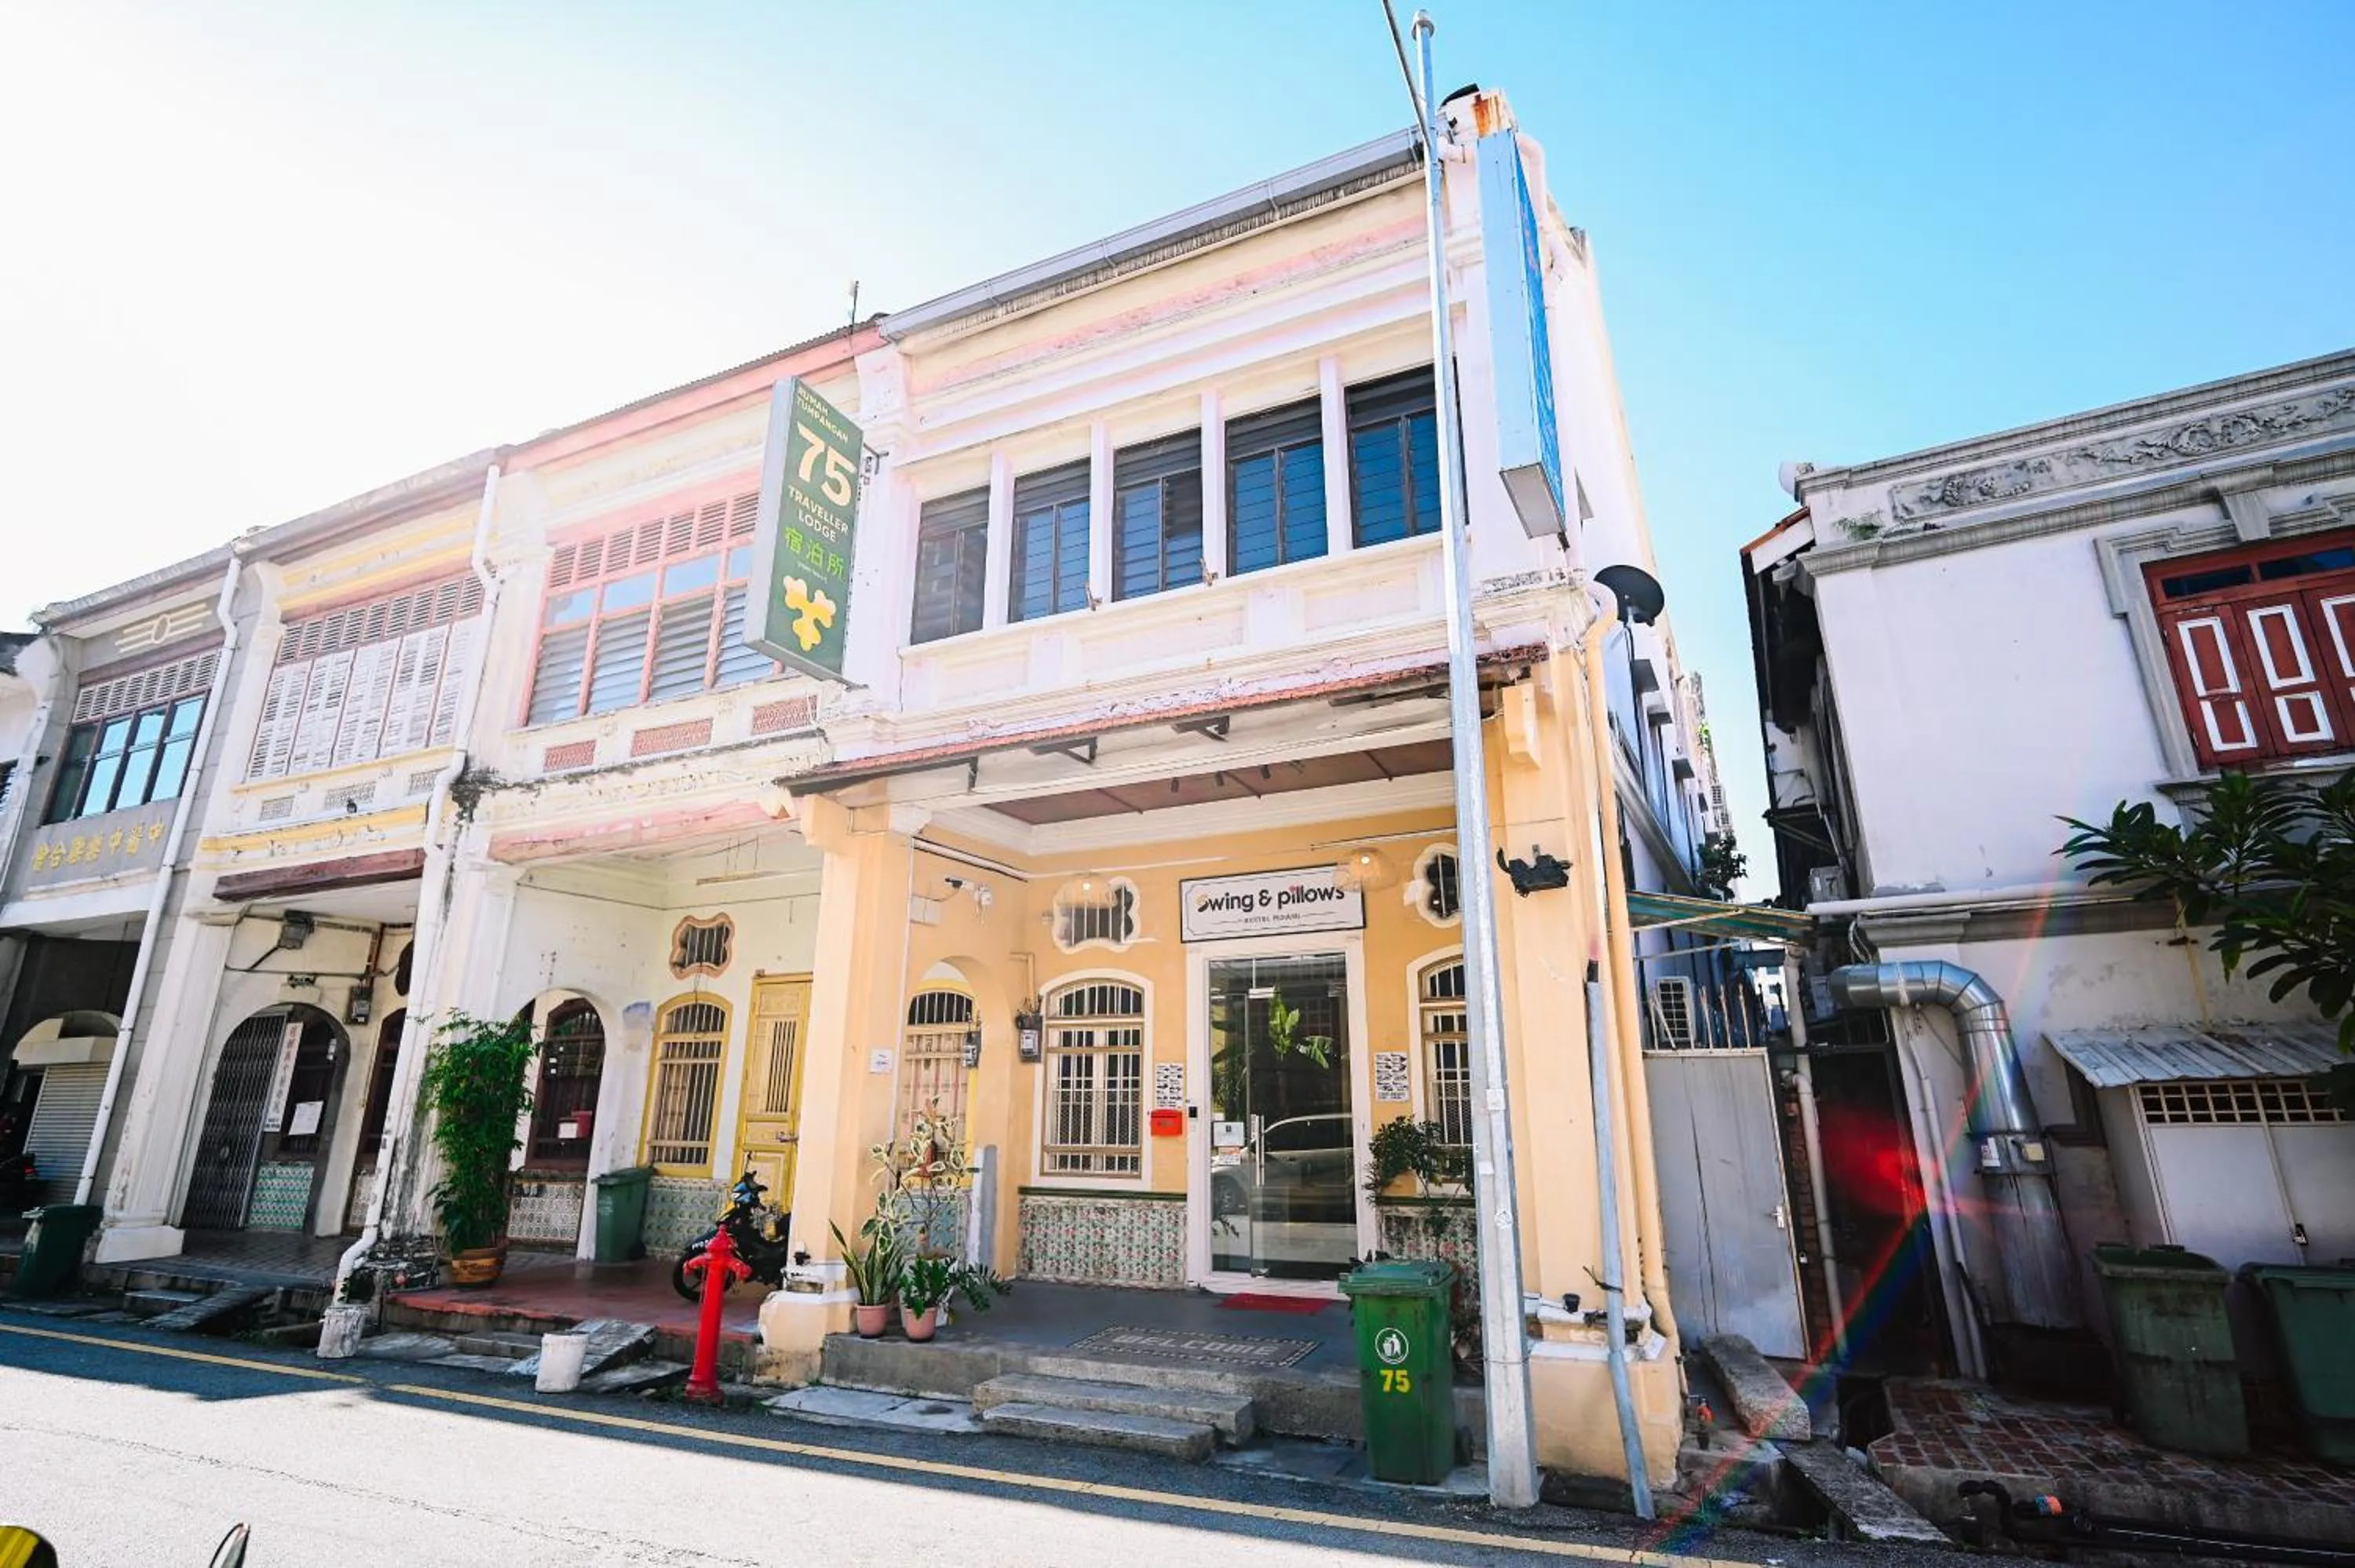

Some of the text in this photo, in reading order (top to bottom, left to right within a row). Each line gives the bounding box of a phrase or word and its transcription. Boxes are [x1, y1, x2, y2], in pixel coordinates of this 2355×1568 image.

[798, 421, 857, 506] 75
[788, 485, 849, 534] TRAVELLER
[798, 509, 836, 542] LODGE
[1258, 889, 1272, 906] &
[1277, 884, 1345, 909] pillows
[1113, 1334, 1279, 1355] WELCOME
[1380, 1369, 1411, 1393] 75
